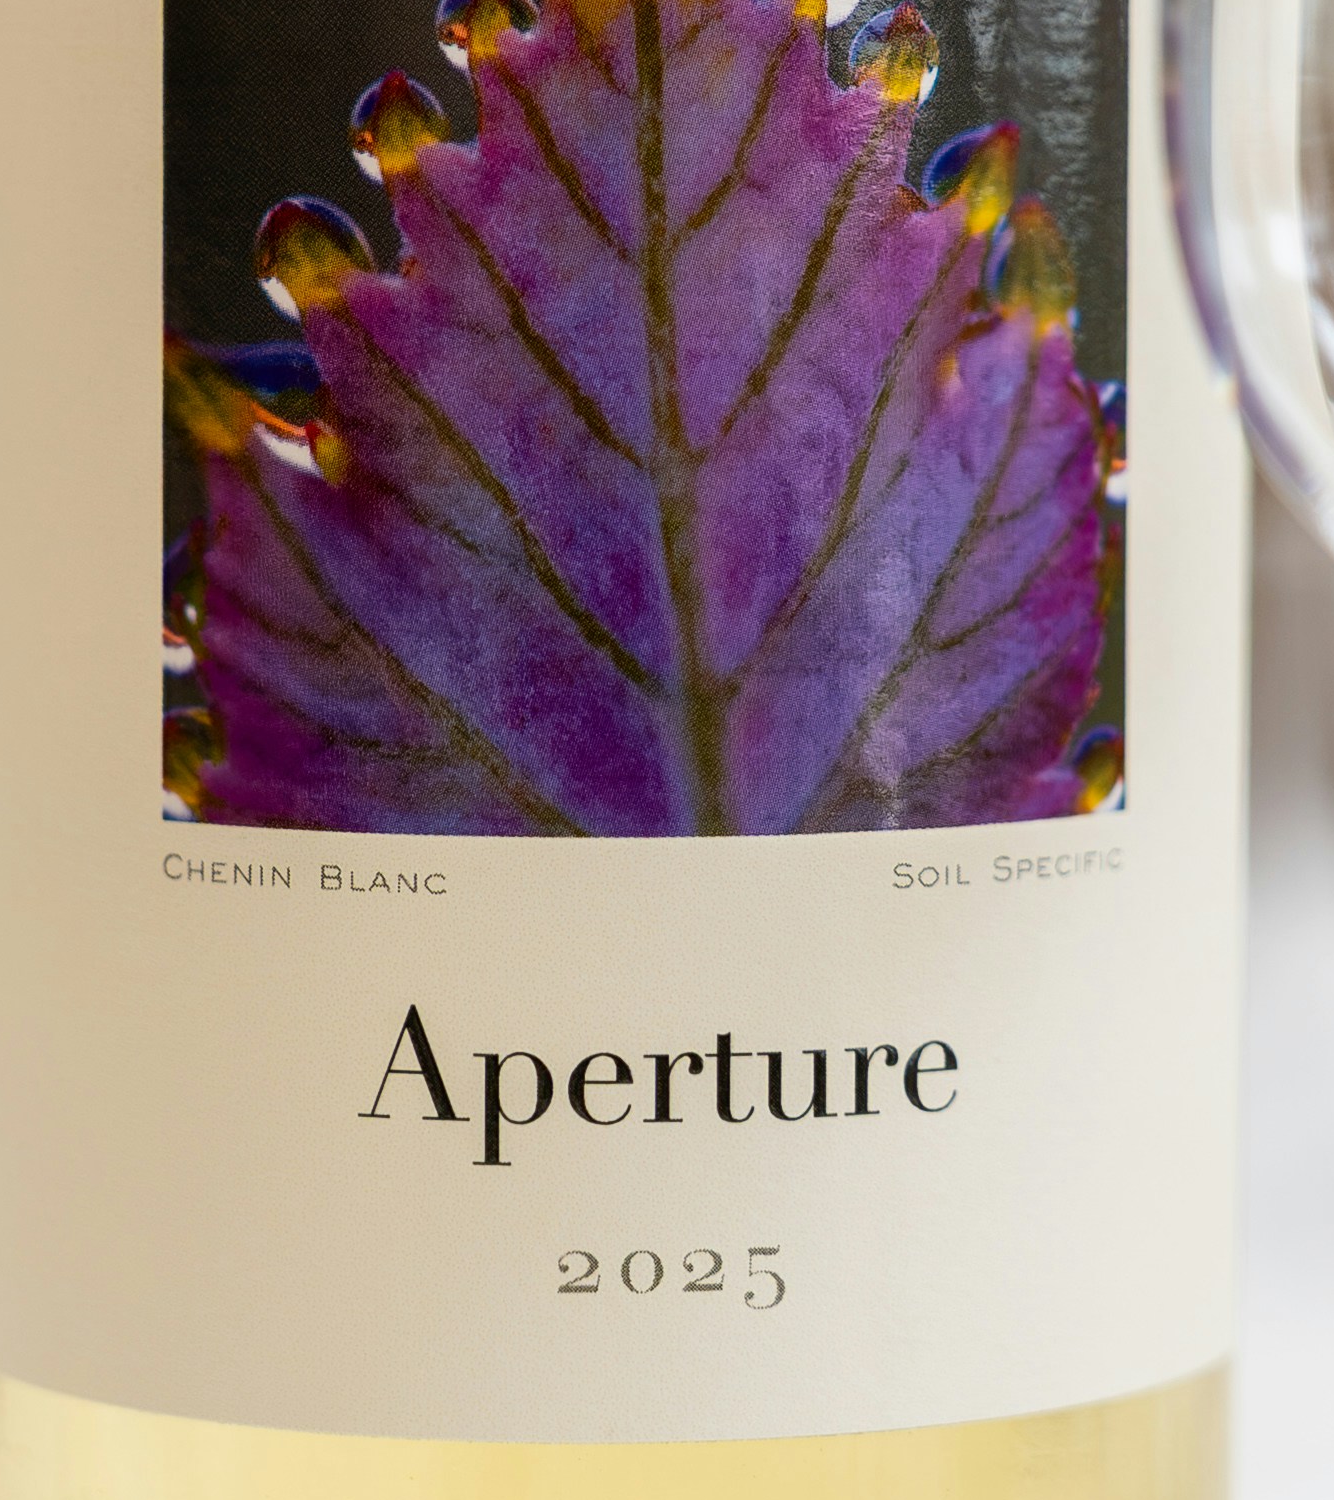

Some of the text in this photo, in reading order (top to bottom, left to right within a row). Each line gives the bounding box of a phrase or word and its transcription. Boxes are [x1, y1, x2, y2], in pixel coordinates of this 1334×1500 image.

[162, 852, 447, 895] CHENIN BLANC
[892, 847, 1124, 889] SOIL SPECIFIC
[357, 1003, 959, 1166] Aperture
[556, 1244, 787, 1310] 2025
